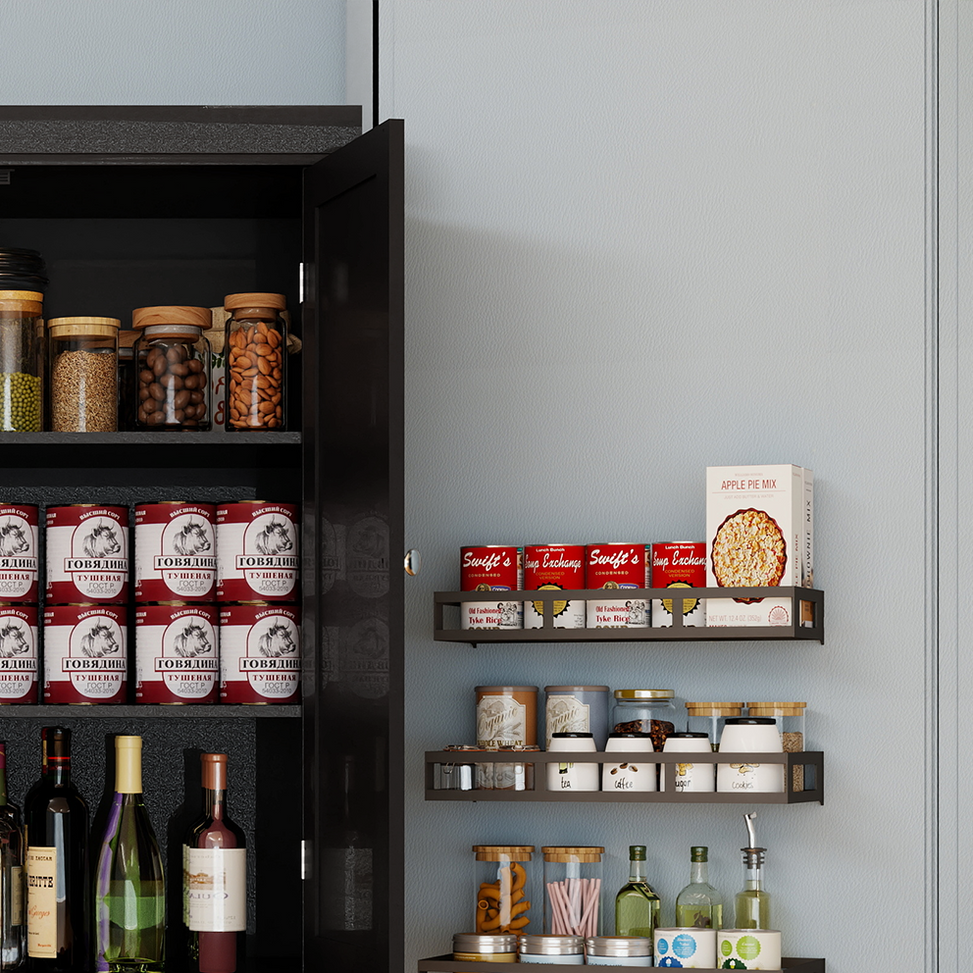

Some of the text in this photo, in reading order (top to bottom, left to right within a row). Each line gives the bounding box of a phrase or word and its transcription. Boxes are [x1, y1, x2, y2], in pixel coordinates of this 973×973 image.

[721, 479, 776, 490] APPLE PIE MIX
[67, 560, 128, 570] ГОВЯДИНА
[463, 552, 511, 571] Swift's
[525, 553, 581, 573] Soup Exchange
[589, 549, 639, 569] Swift's
[653, 550, 706, 571] Soup Exchang
[469, 617, 483, 625] Tyke
[65, 660, 126, 670] ГОВЯДИНА
[478, 706, 518, 737] Organic
[561, 777, 571, 789] tea
[675, 780, 691, 792] ugar
